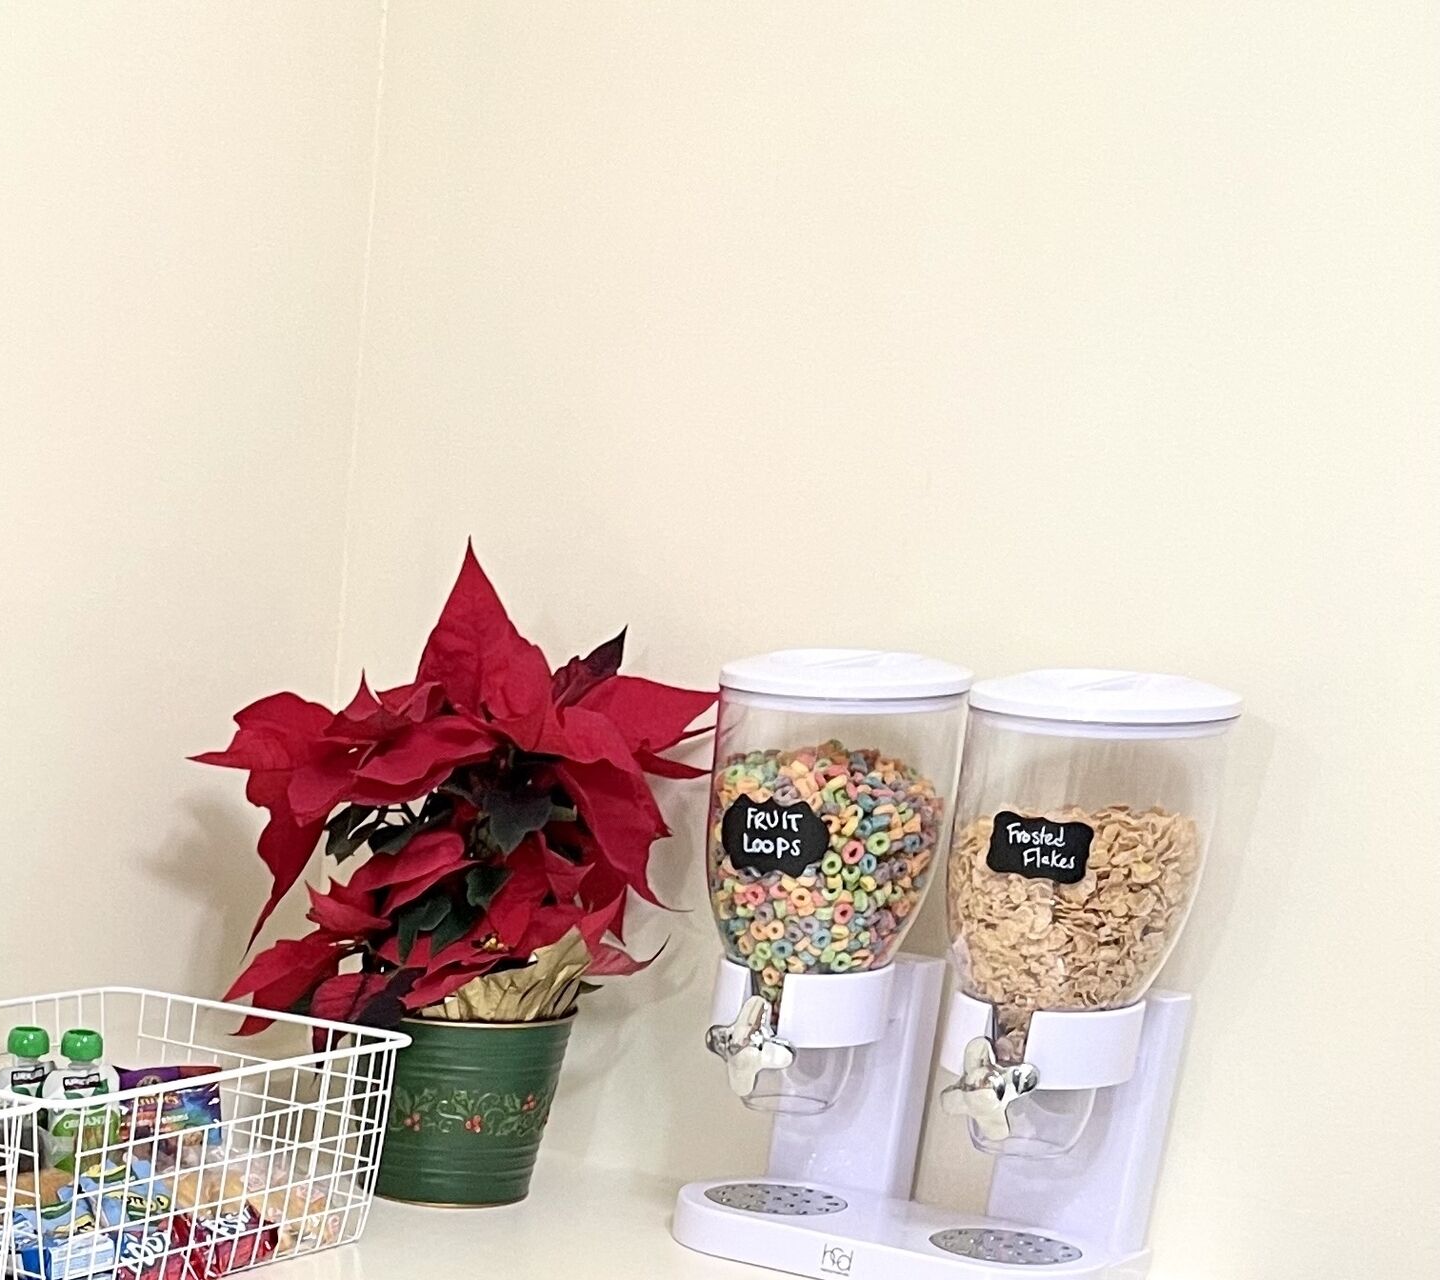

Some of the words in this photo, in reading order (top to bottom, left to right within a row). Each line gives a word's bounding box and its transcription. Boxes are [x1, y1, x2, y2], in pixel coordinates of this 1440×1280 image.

[747, 807, 803, 832] FRUIT
[743, 832, 801, 859] LOOPS
[1006, 822, 1066, 847] Frosted
[1023, 847, 1076, 870] Flakes
